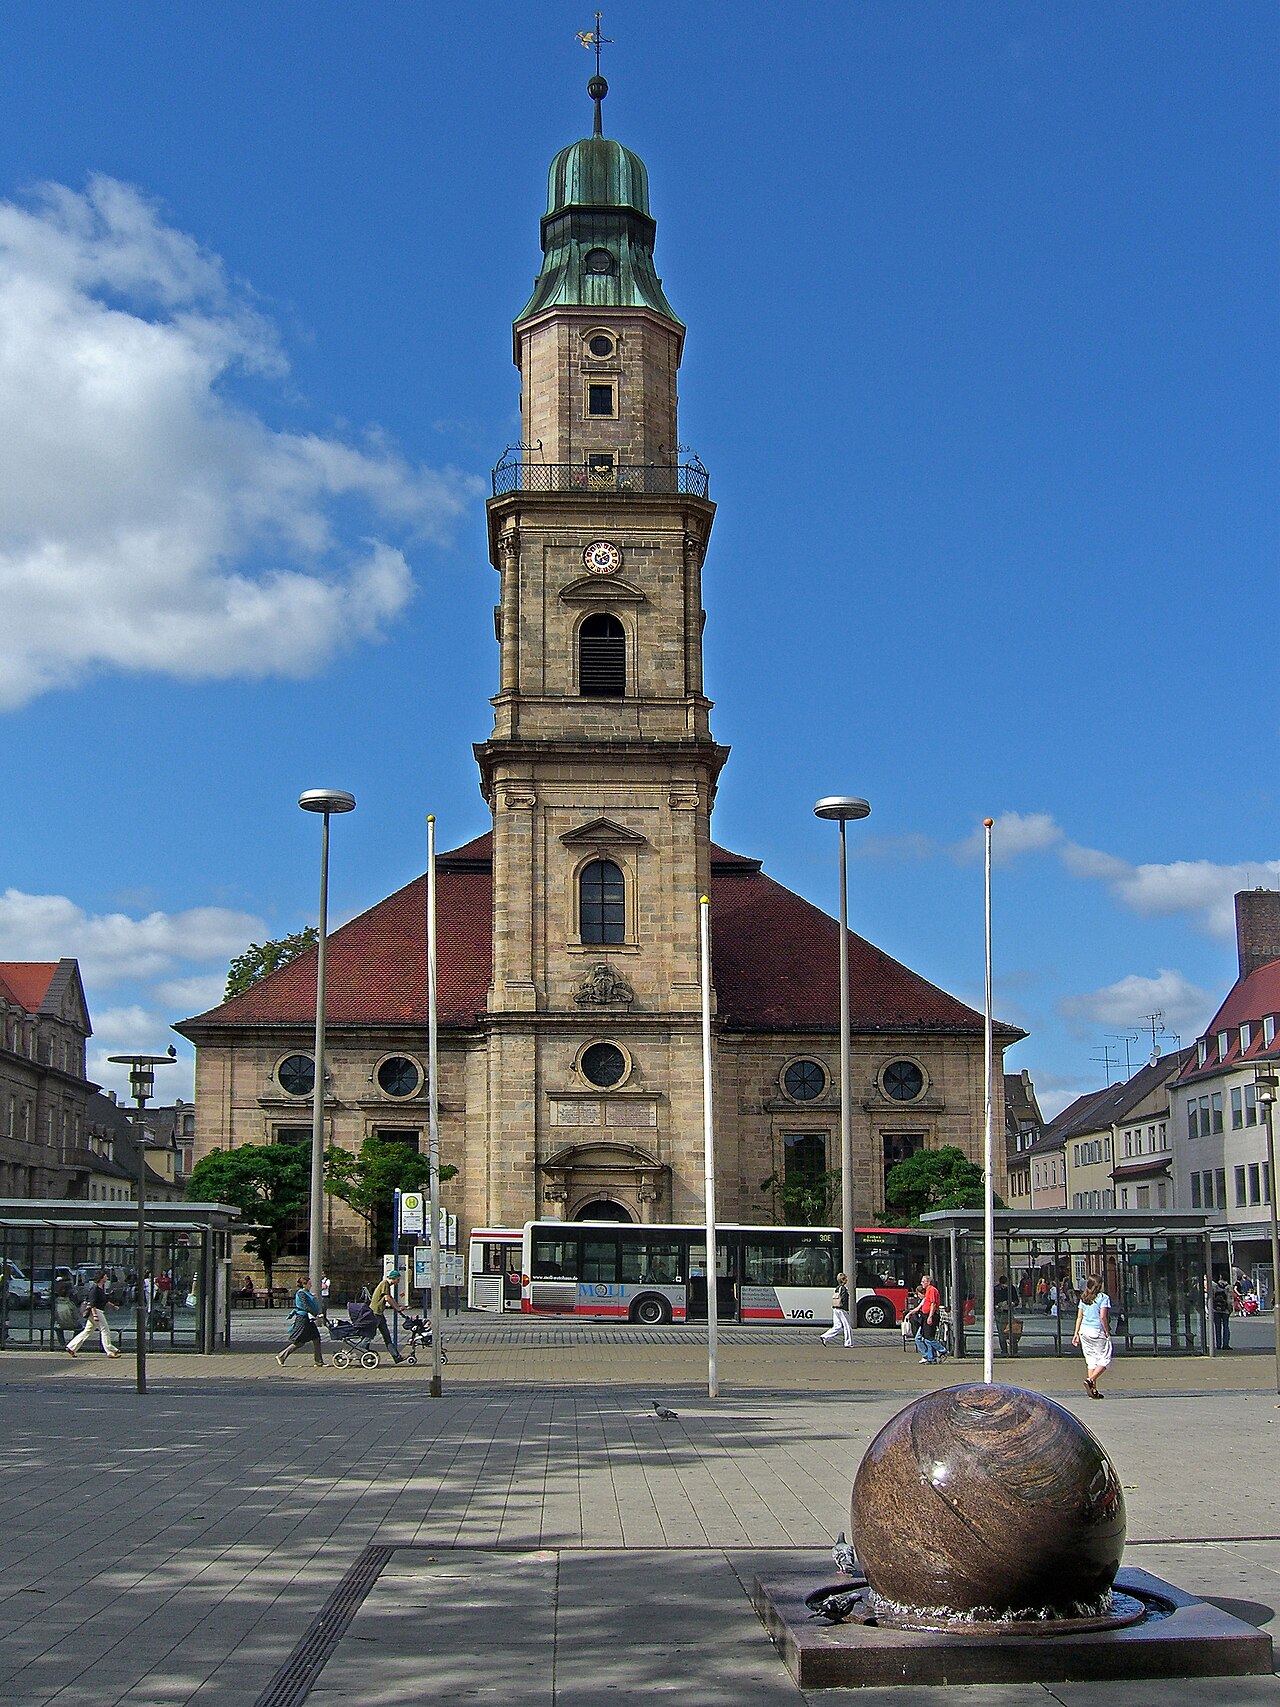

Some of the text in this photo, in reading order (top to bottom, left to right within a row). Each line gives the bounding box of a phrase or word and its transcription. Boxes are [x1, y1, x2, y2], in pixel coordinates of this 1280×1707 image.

[819, 1233, 832, 1242] 30E
[577, 1283, 631, 1298] MOLL
[790, 1309, 814, 1320] VAG
